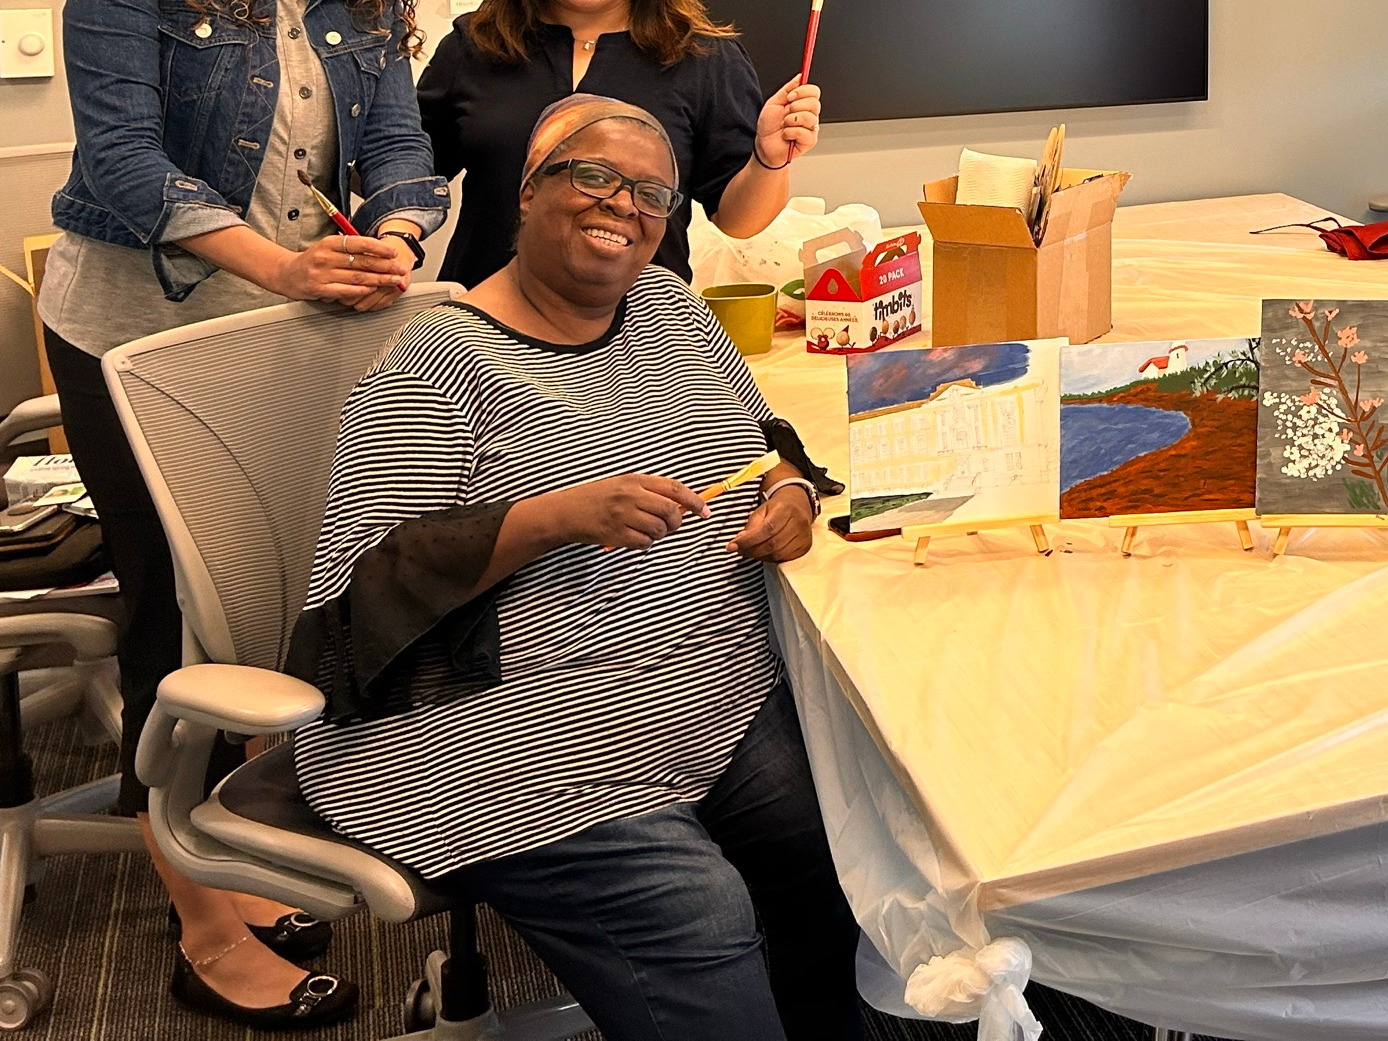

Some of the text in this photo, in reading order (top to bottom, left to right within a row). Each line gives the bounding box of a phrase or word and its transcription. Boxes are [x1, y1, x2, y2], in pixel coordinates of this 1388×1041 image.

[878, 267, 904, 285] 20 PACK
[873, 289, 912, 322] timbits
